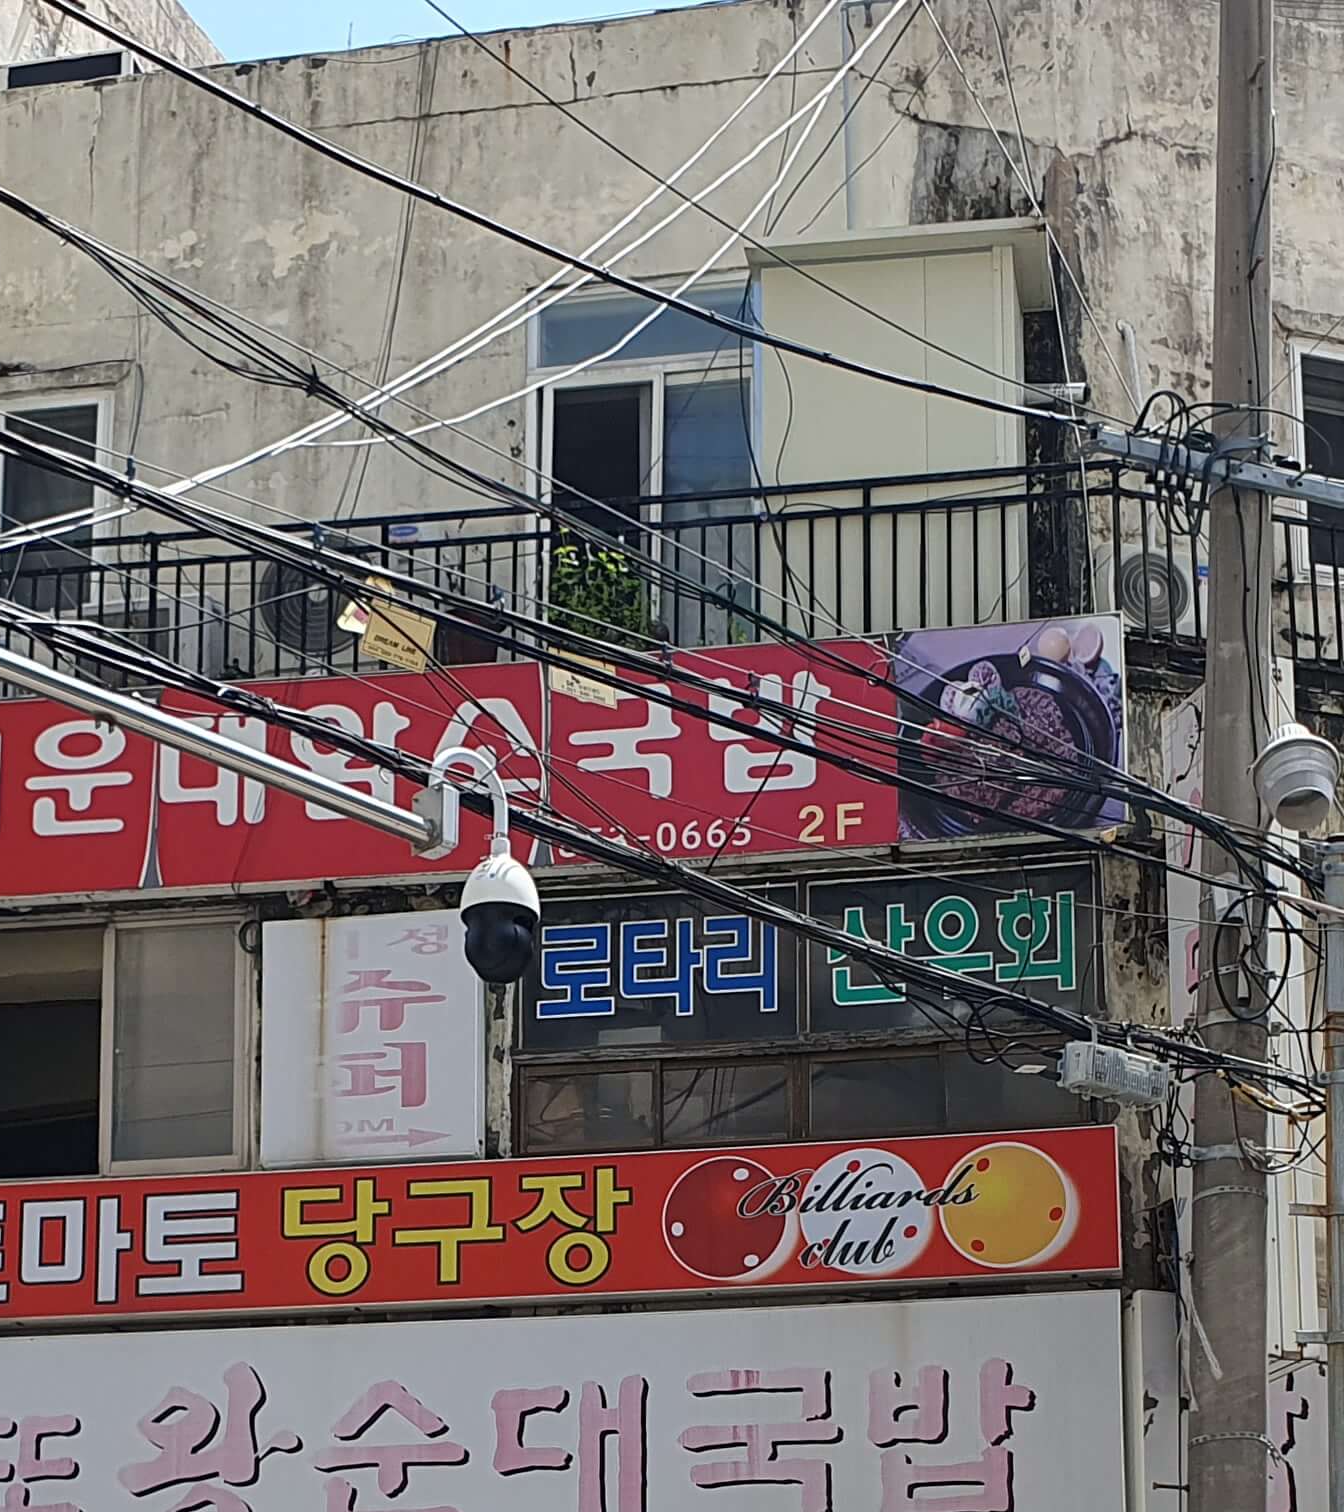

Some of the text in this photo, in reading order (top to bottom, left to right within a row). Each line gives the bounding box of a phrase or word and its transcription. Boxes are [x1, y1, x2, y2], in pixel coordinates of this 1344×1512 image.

[799, 801, 865, 843] 2F
[536, 913, 778, 1018] 로타리
[737, 1162, 981, 1221] Billiards
[281, 1165, 633, 1297] 당구장
[798, 1215, 898, 1270] club
